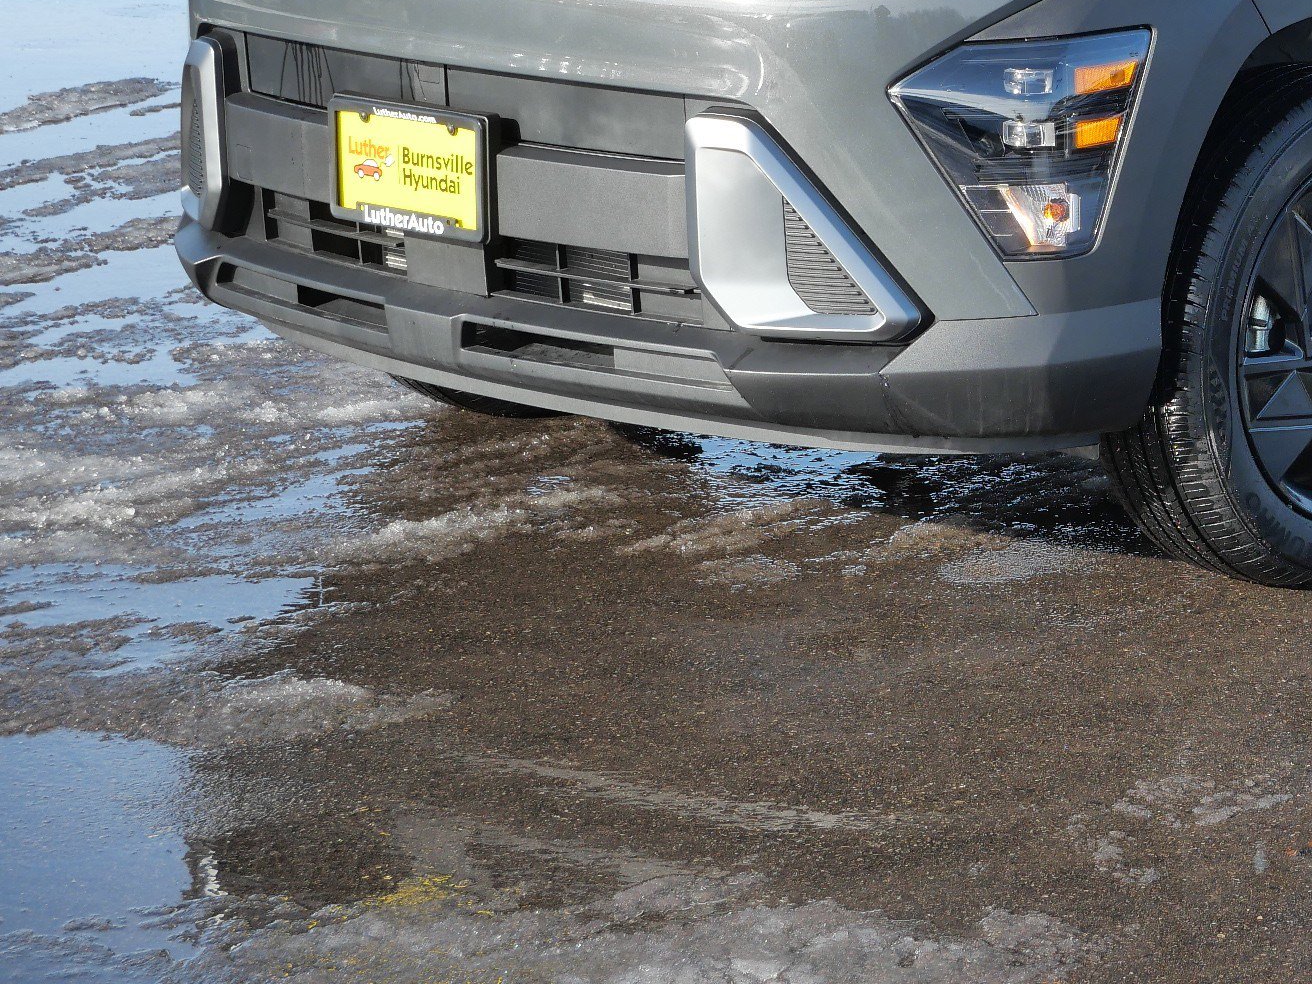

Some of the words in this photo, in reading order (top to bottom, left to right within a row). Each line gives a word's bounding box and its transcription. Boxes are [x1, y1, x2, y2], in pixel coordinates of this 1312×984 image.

[348, 135, 390, 160] Luther
[402, 146, 474, 176] Burnsville
[402, 167, 461, 195] Hyundai
[363, 204, 445, 235] LutherAuto
